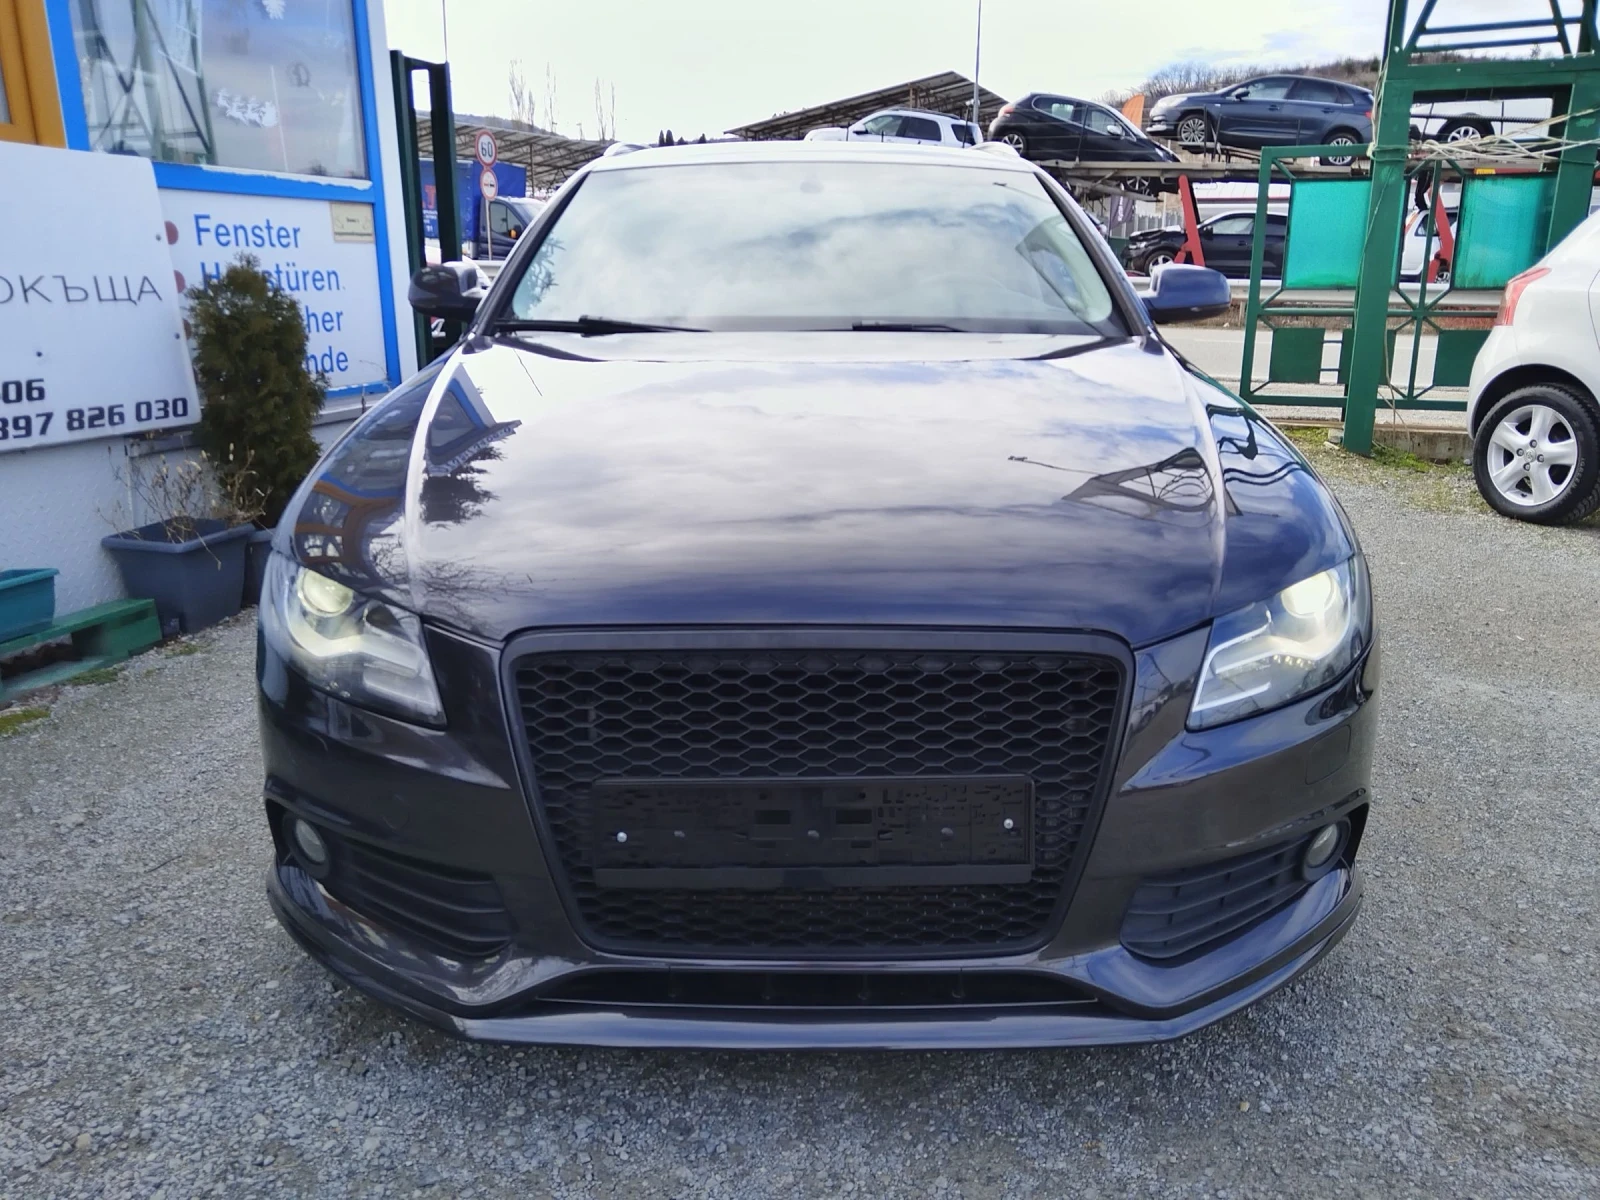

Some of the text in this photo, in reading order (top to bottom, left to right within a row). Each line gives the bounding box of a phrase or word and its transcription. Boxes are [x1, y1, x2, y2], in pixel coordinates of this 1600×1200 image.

[481, 141, 493, 158] 60
[194, 213, 301, 248] Fenster
[200, 262, 341, 293] Hstüren
[66, 403, 125, 432] 826
[135, 397, 189, 423] 030
